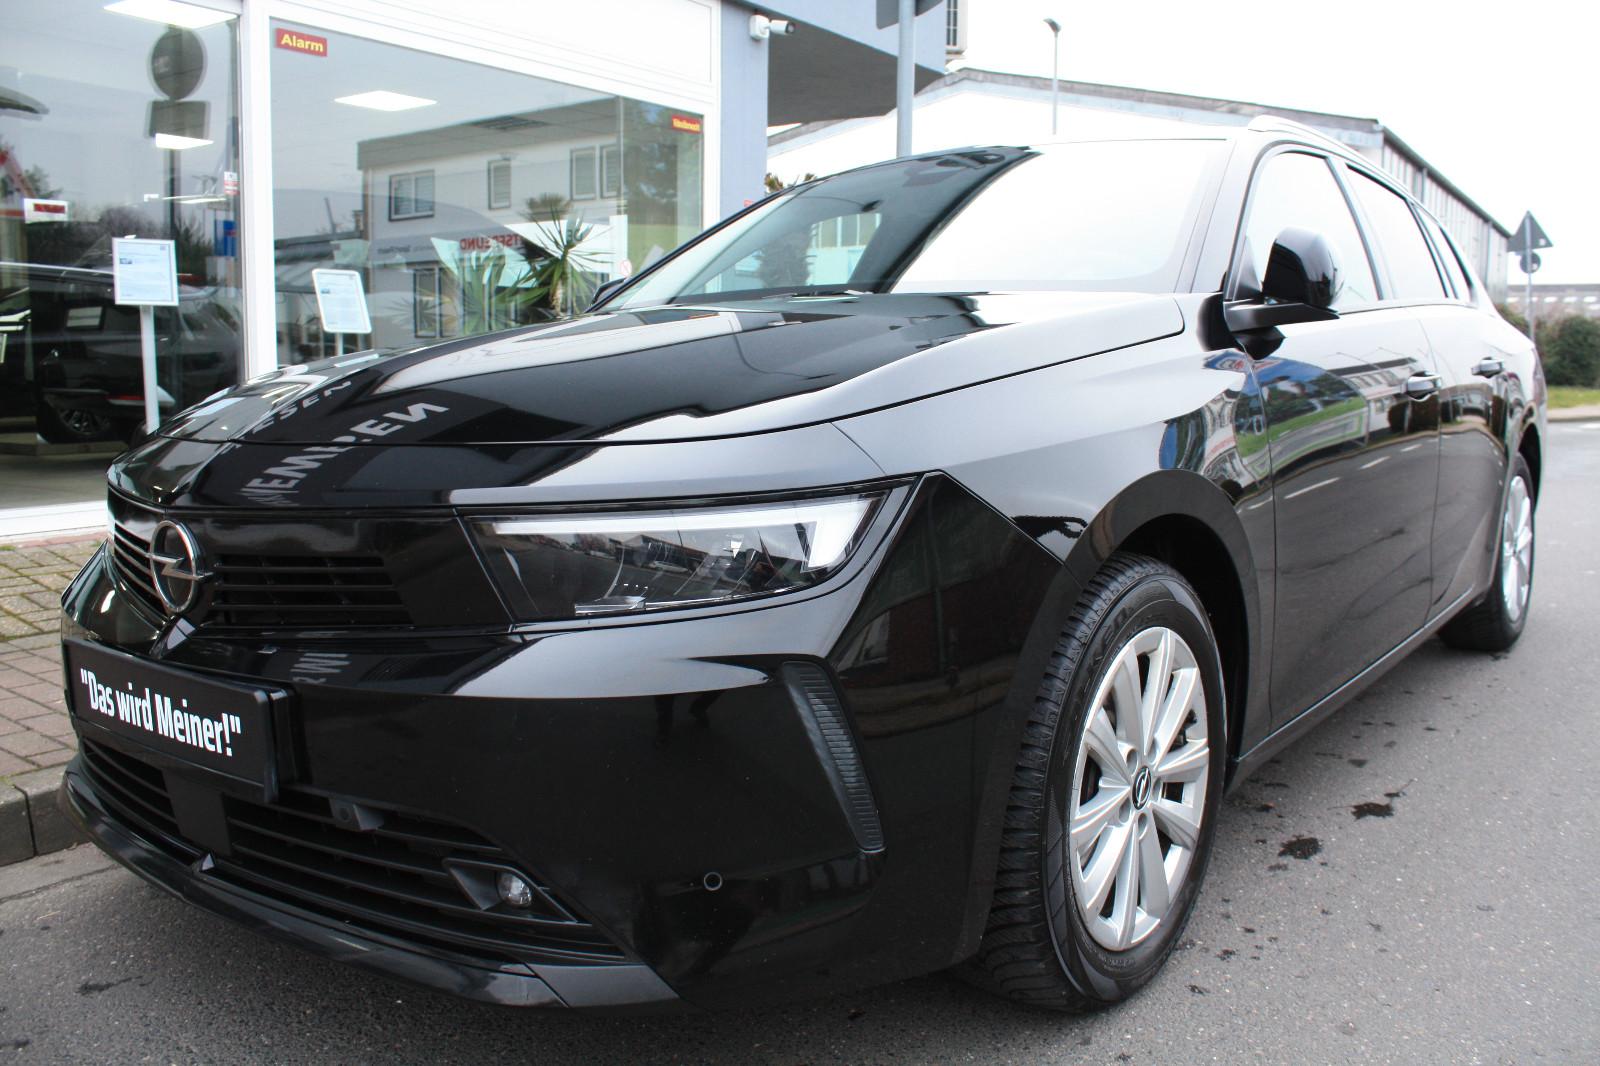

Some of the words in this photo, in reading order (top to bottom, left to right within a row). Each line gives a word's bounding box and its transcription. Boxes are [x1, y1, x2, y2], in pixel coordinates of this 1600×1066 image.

[281, 33, 323, 52] Alarm
[80, 668, 115, 717] "Das
[115, 682, 154, 732] wird
[154, 693, 242, 757] Meiner!"
